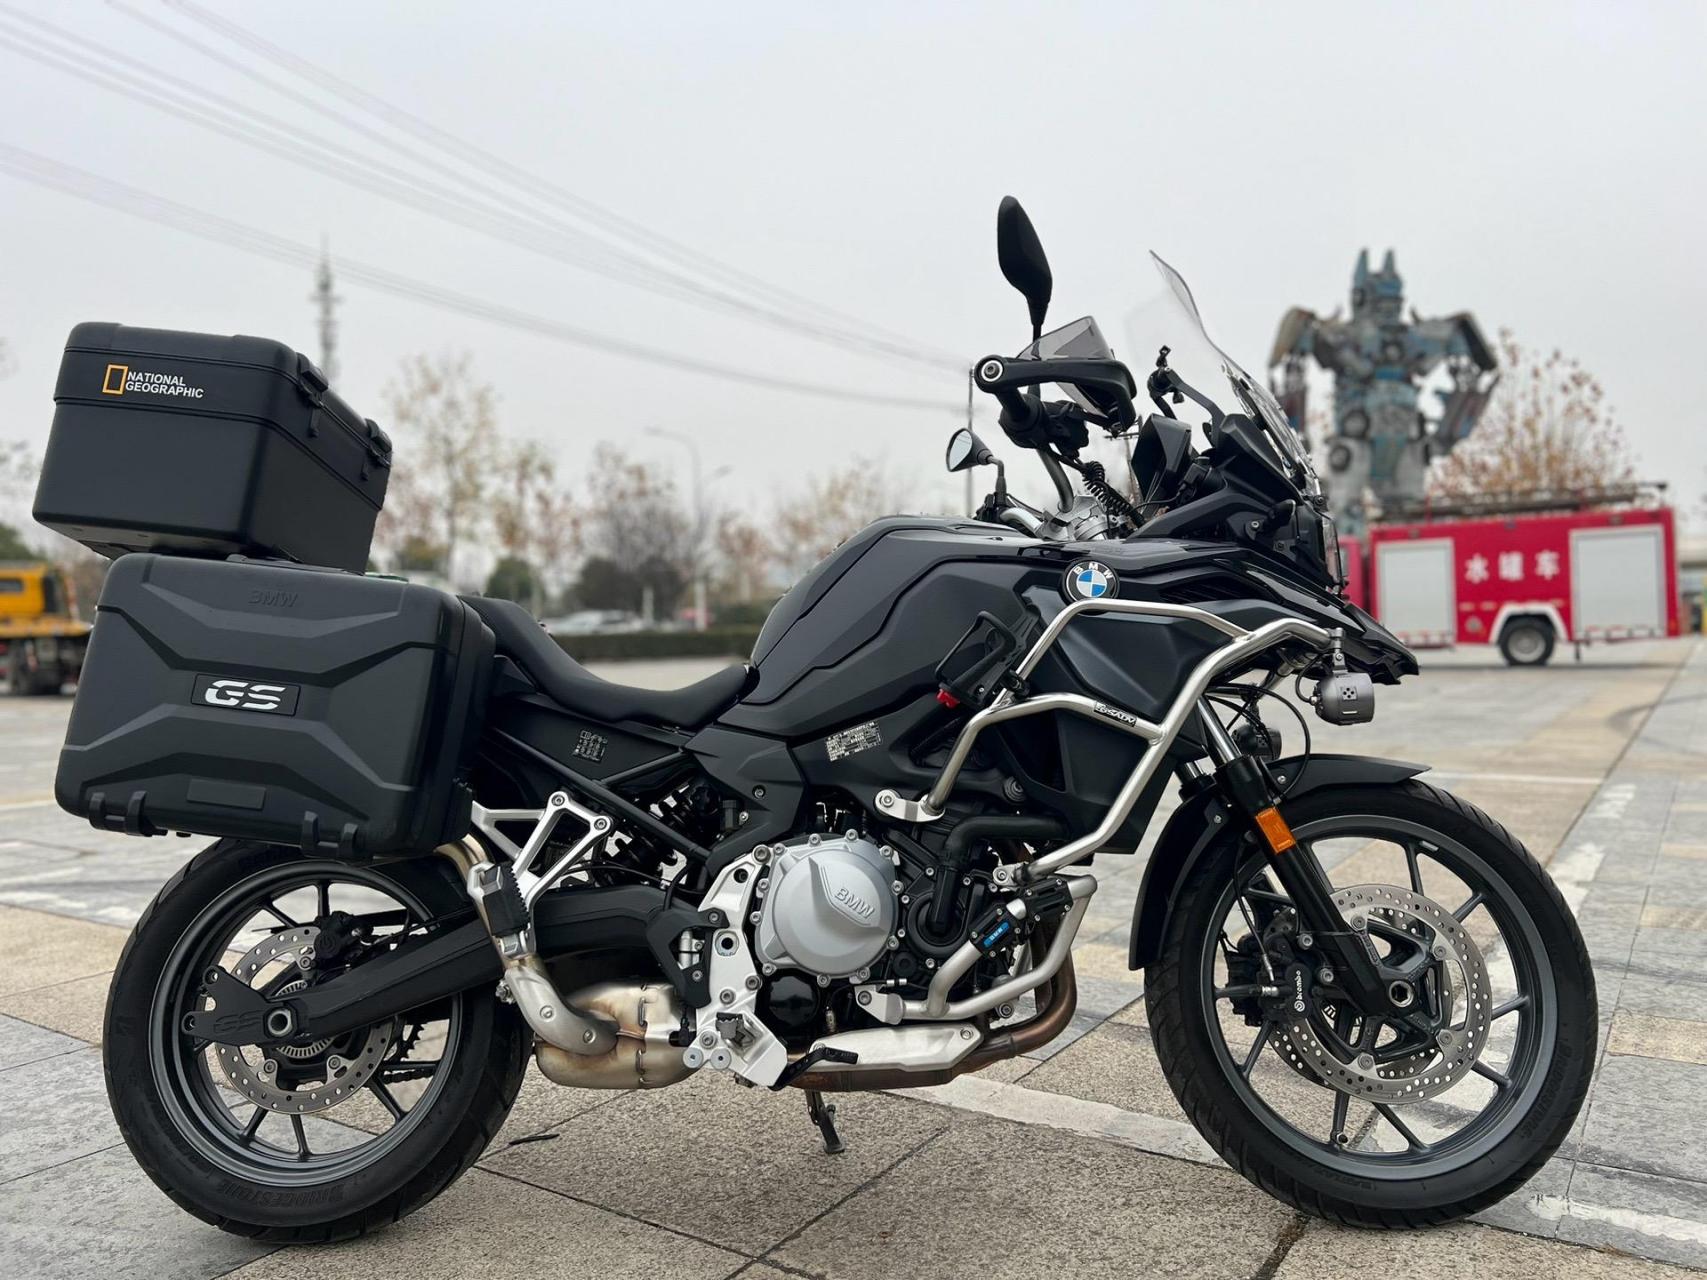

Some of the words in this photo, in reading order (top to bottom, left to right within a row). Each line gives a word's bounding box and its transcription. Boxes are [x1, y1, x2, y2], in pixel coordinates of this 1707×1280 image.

[127, 371, 186, 387] NATIONAL
[125, 381, 204, 398] GEOGRAPHIC
[1073, 561, 1114, 579] BMW
[247, 589, 298, 608] BMW
[205, 680, 286, 710] GS
[834, 888, 876, 919] BMW
